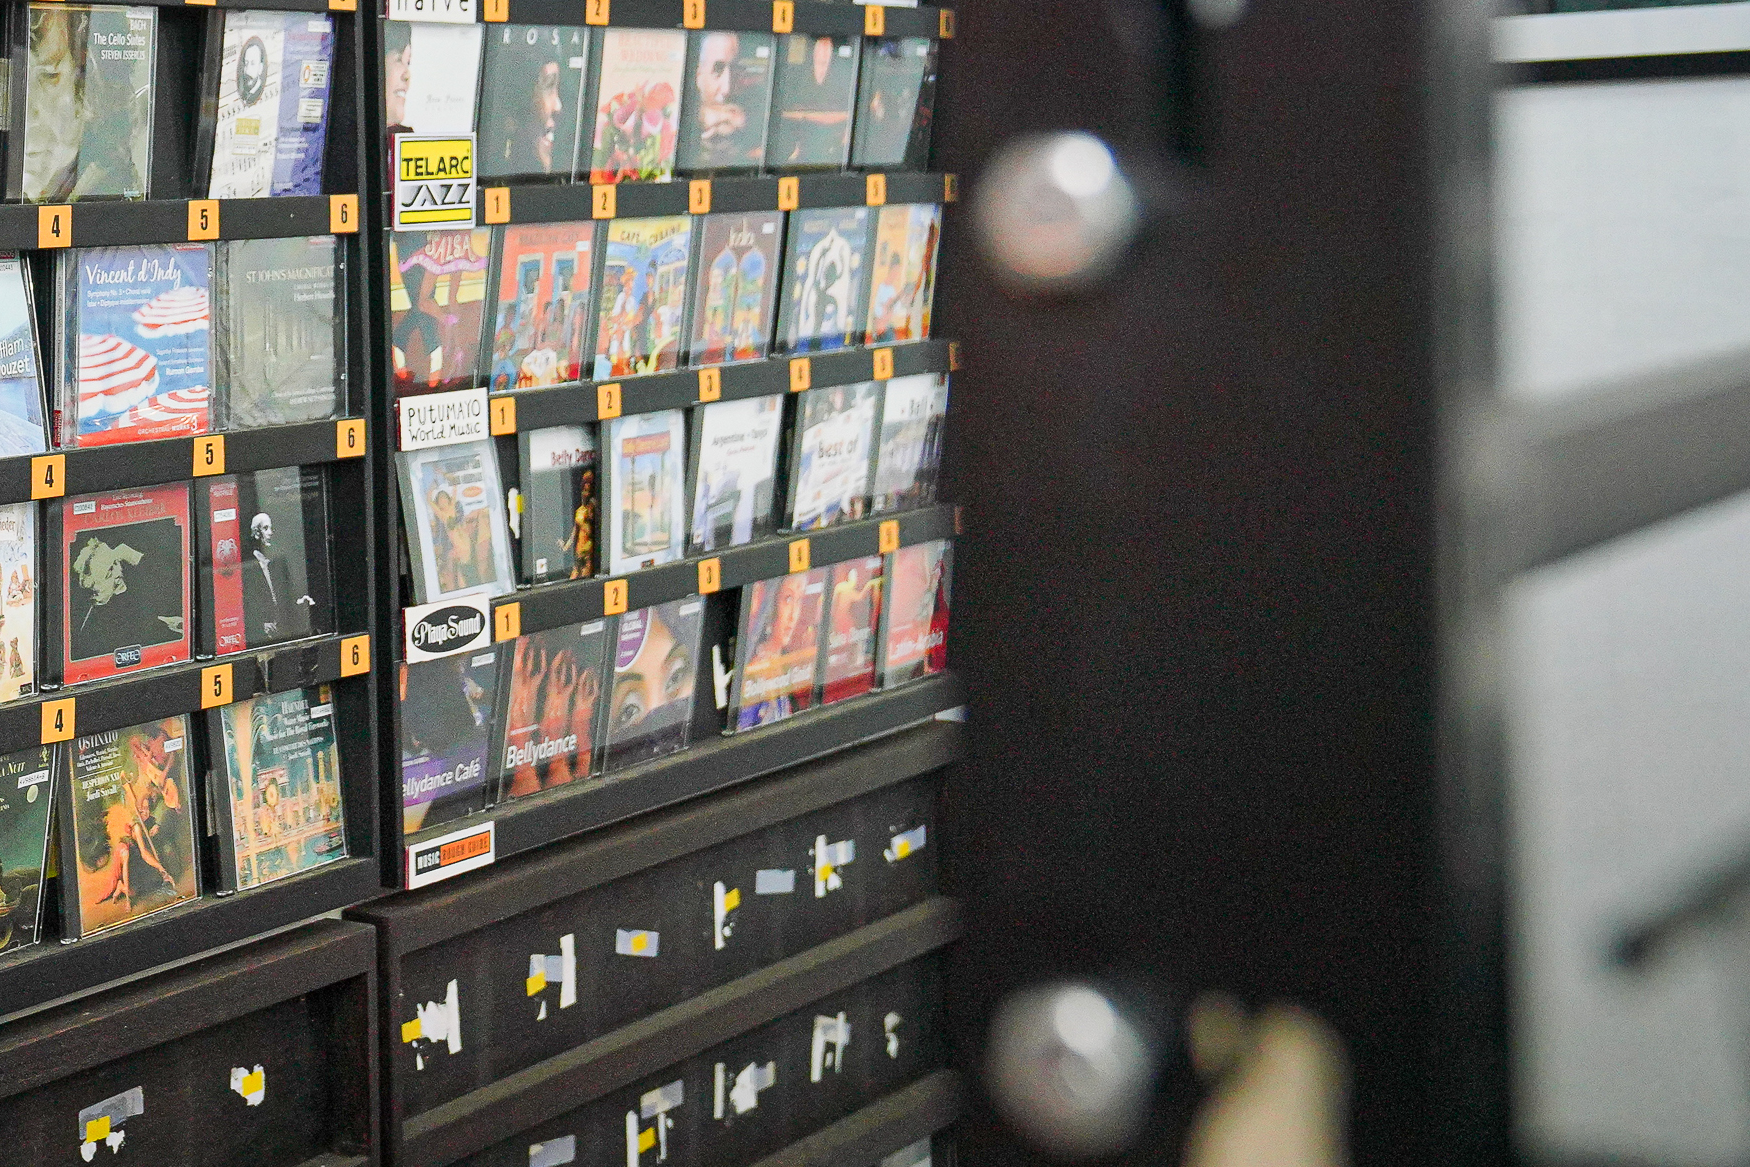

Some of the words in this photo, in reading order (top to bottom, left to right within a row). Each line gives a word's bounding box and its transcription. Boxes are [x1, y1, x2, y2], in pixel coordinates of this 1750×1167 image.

[93, 33, 106, 45] The
[106, 33, 126, 46] Cello
[402, 155, 470, 177] TELARC
[402, 184, 471, 208] JAZZ
[601, 192, 607, 211] 2
[200, 209, 209, 230] 5
[340, 204, 348, 224] 6
[51, 215, 61, 237] 4
[426, 233, 472, 258] SALSA
[86, 262, 136, 285] Vincent
[138, 257, 182, 287] d'Indy
[606, 391, 613, 410] 2
[348, 428, 355, 448] 6
[408, 424, 446, 443] World
[446, 421, 481, 439] Music
[205, 443, 214, 463] 5
[552, 450, 574, 466] Belly
[44, 464, 54, 488] 4
[612, 587, 619, 606] 2
[351, 644, 359, 664] 6
[213, 676, 222, 698] 5
[54, 708, 64, 732] 4
[506, 733, 578, 769] Bellydance
[7, 761, 27, 776] NUIT
[454, 757, 482, 779] Café
[417, 851, 440, 870] MUSIC
[467, 835, 489, 854] GUIDE
